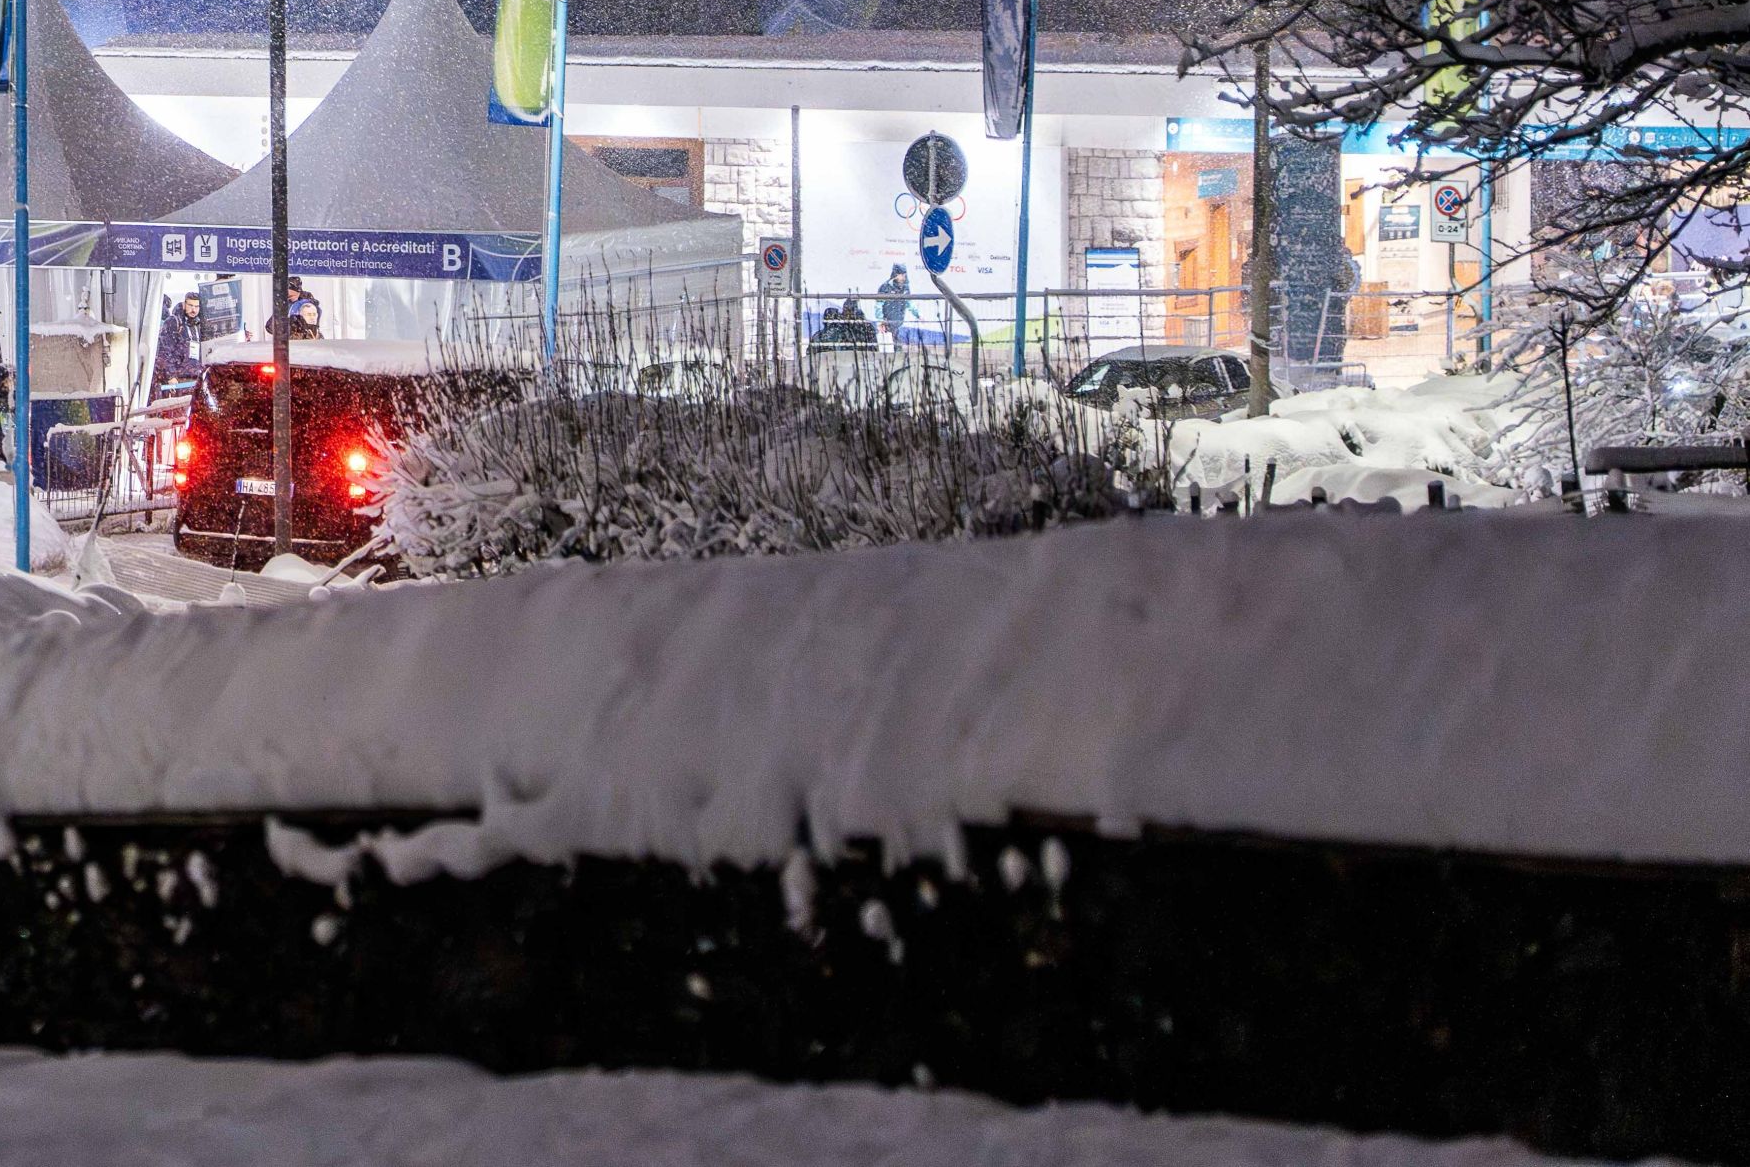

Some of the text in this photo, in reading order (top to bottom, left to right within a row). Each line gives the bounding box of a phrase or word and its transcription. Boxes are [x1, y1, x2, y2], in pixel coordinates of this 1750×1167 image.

[226, 236, 273, 252] Ingress
[351, 242, 360, 253] e
[362, 240, 435, 254] Accreditati
[296, 257, 348, 268] Accredited
[350, 259, 393, 270] Entrance
[442, 243, 462, 272] B
[978, 266, 993, 274] VISA
